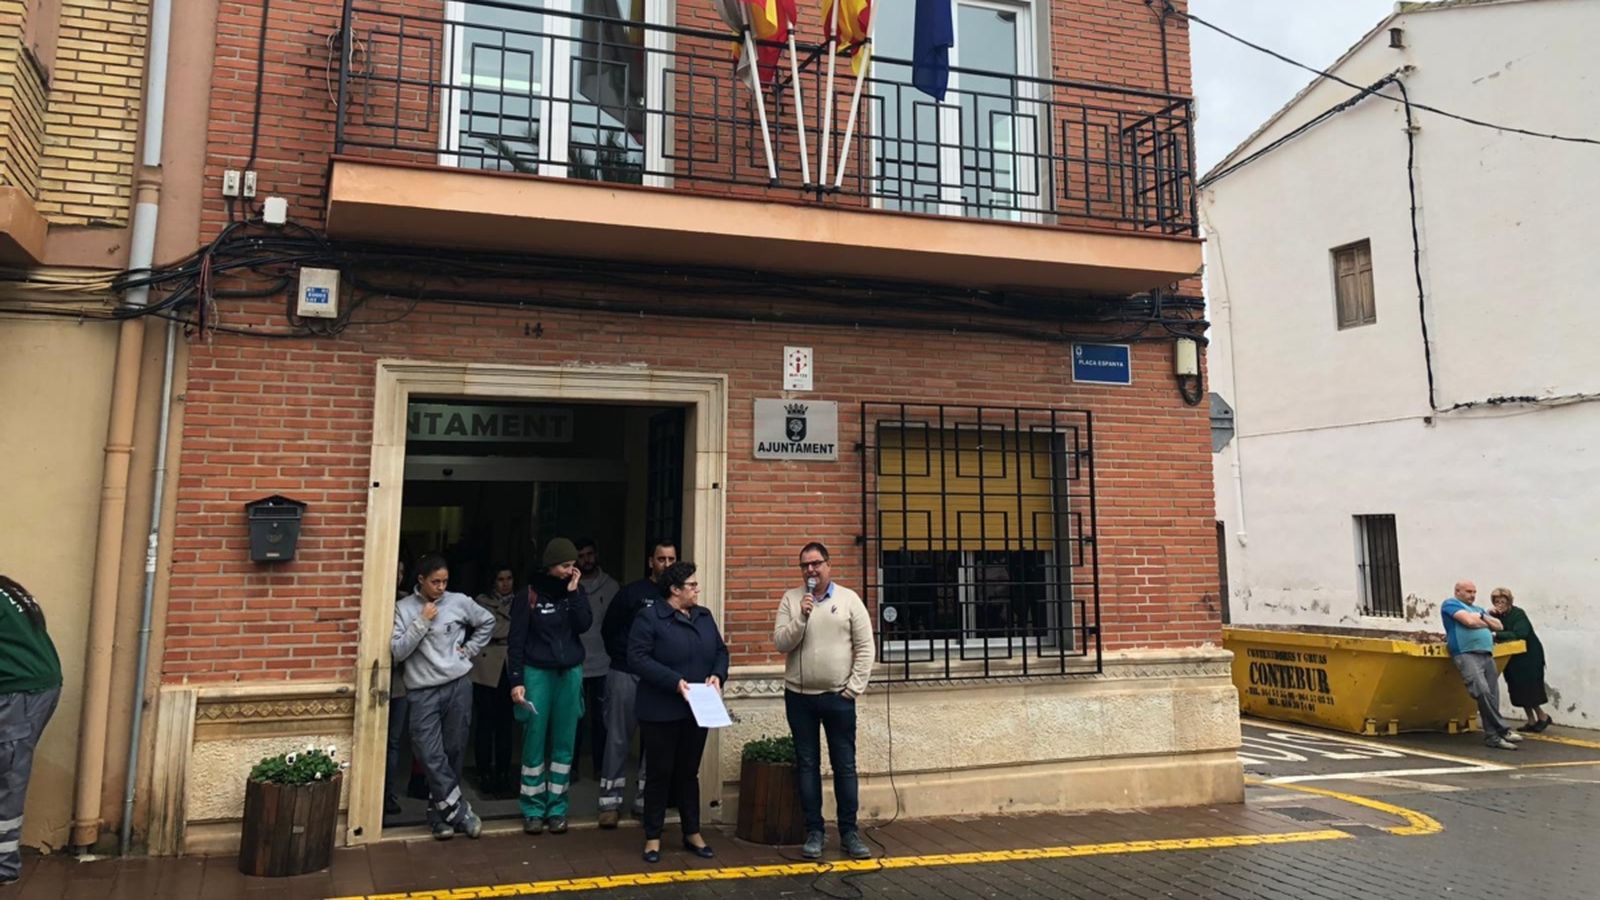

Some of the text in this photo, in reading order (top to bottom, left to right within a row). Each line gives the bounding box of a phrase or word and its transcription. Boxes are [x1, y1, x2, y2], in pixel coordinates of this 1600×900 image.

[1098, 360, 1124, 368] ESPANYA
[757, 442, 835, 454] AJUNTAMENT
[1297, 652, 1302, 662] Y
[1249, 661, 1331, 694] CONTEBUR
